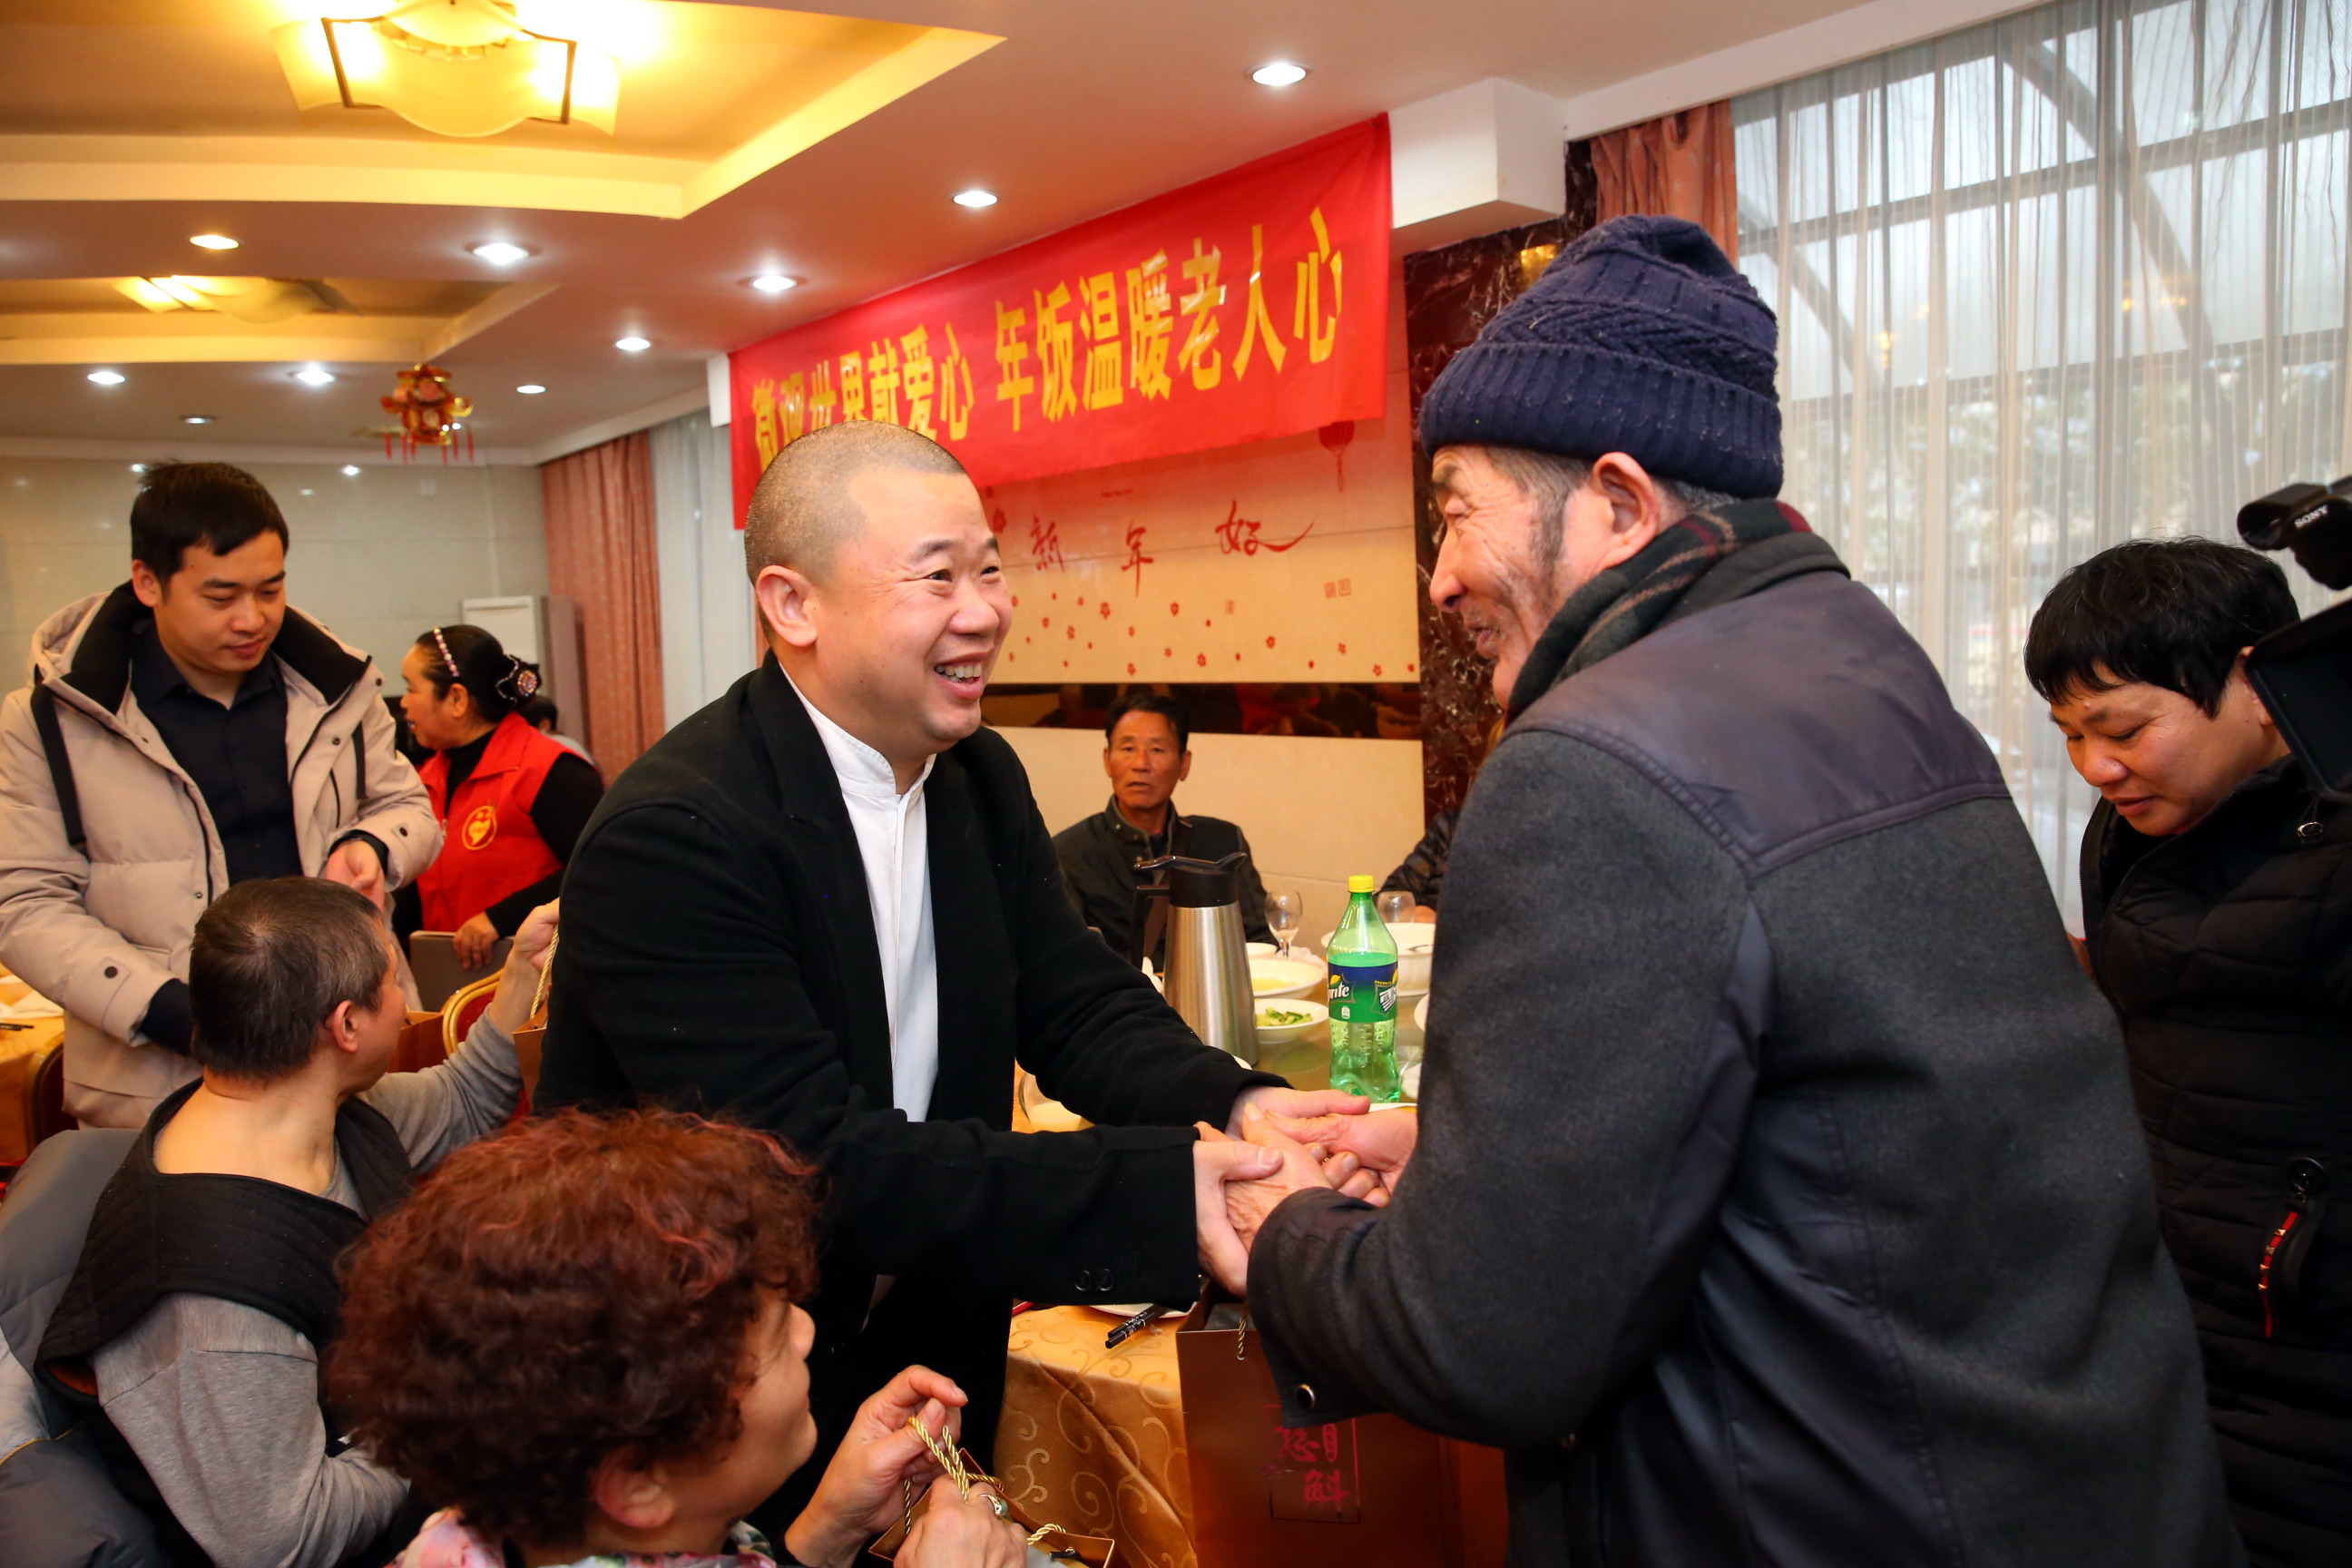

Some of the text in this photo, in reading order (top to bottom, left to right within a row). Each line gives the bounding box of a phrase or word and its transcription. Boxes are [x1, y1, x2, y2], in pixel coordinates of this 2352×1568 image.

[995, 206, 1343, 432] 年饭温暖老人心
[1030, 500, 1315, 598] 新年好
[2294, 505, 2328, 528] SONY
